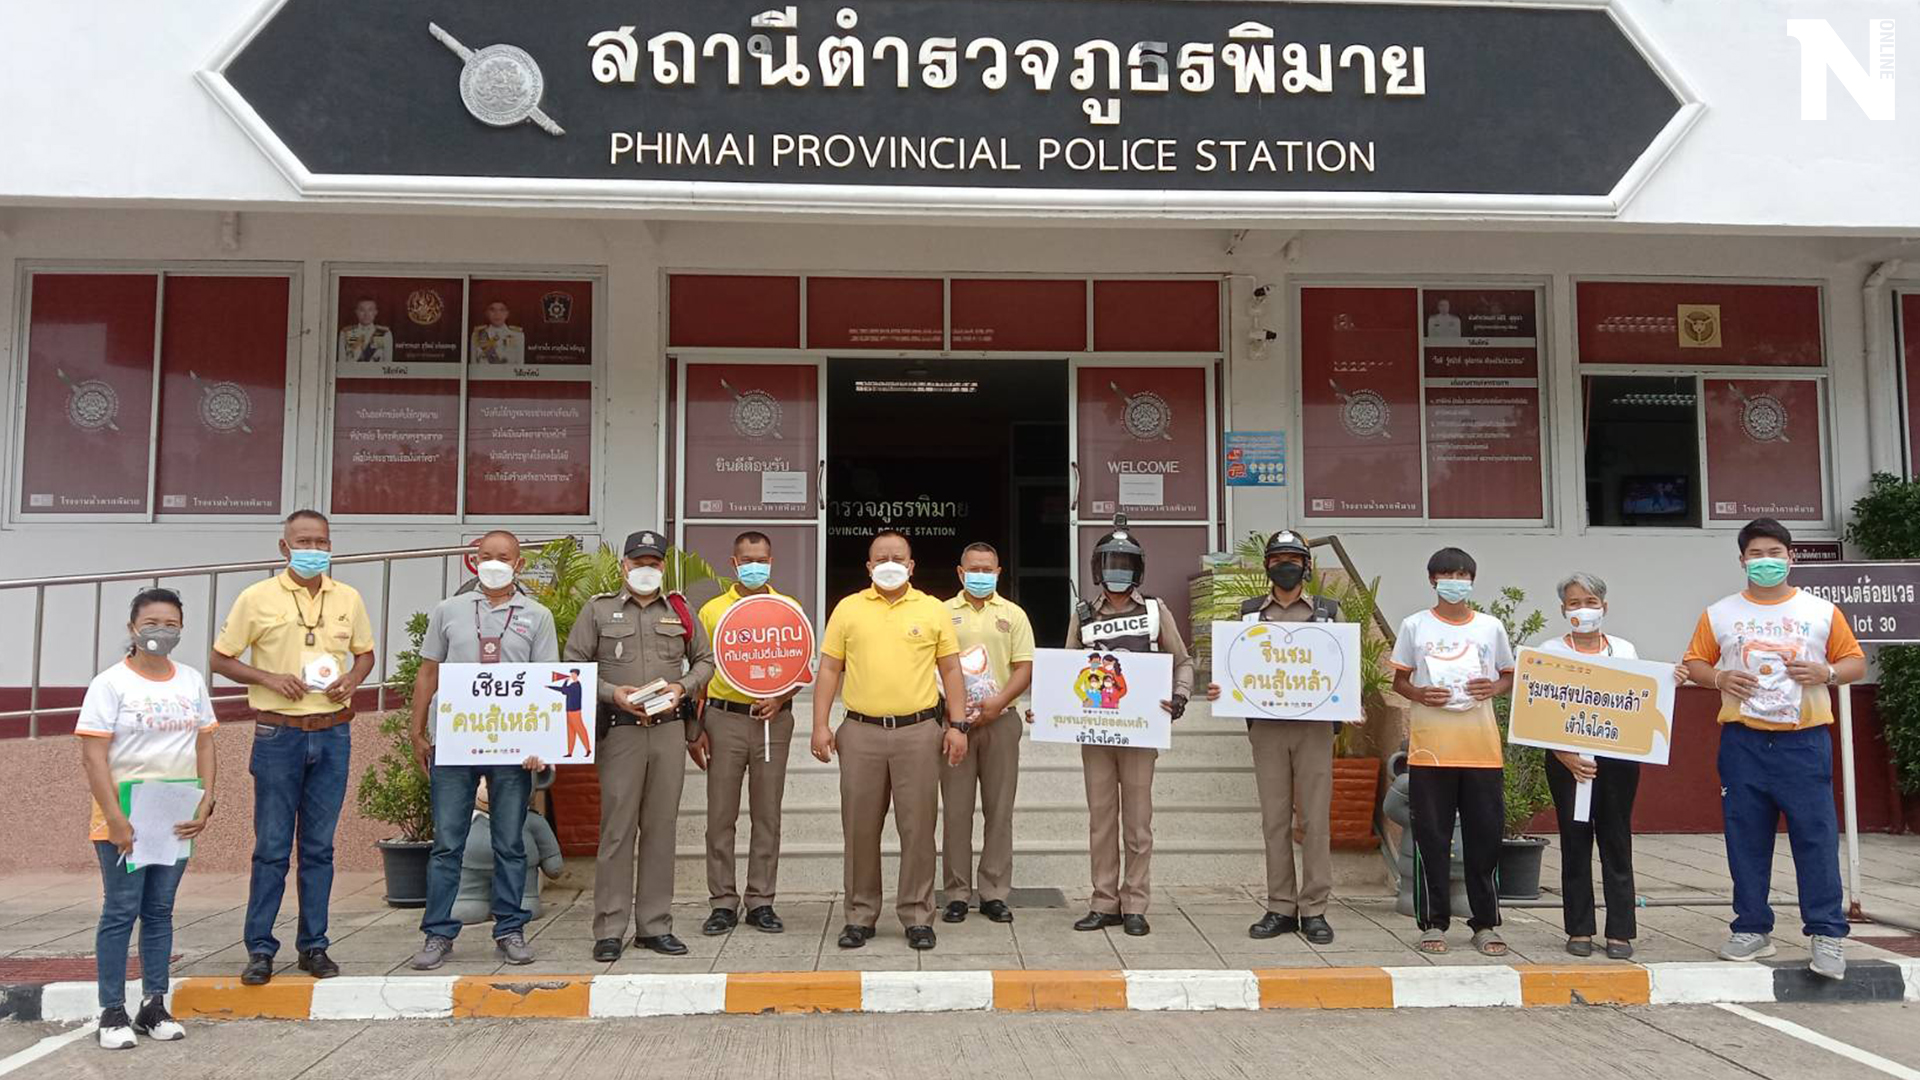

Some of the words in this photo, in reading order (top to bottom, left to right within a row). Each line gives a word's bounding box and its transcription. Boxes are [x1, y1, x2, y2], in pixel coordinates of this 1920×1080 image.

[587, 6, 1426, 124] สถานีตำรวจภูธรพิมาย
[610, 132, 754, 164] PHIMAI
[772, 134, 1021, 170] PROVINCIAL
[1038, 138, 1177, 171] POLICE
[1195, 139, 1375, 172] STATION
[716, 457, 790, 472] ยินดีต้อนรับ
[1107, 461, 1180, 473] WELCOME
[915, 526, 956, 536] STATION
[1093, 617, 1149, 635] POLICE
[1880, 617, 1897, 632] 30
[1260, 635, 1312, 664] ชื่นชม
[472, 671, 526, 697] เชียร์
[1243, 668, 1331, 698] คนสู้เหล้า
[1522, 674, 1649, 710] “ชุมชนสุขปลอดเหล้า”
[440, 702, 563, 743] “คนสู้เหล้า”
[1565, 711, 1619, 740] เข้าใจโควิด
[1076, 729, 1130, 745] เข้าใจโควิด
